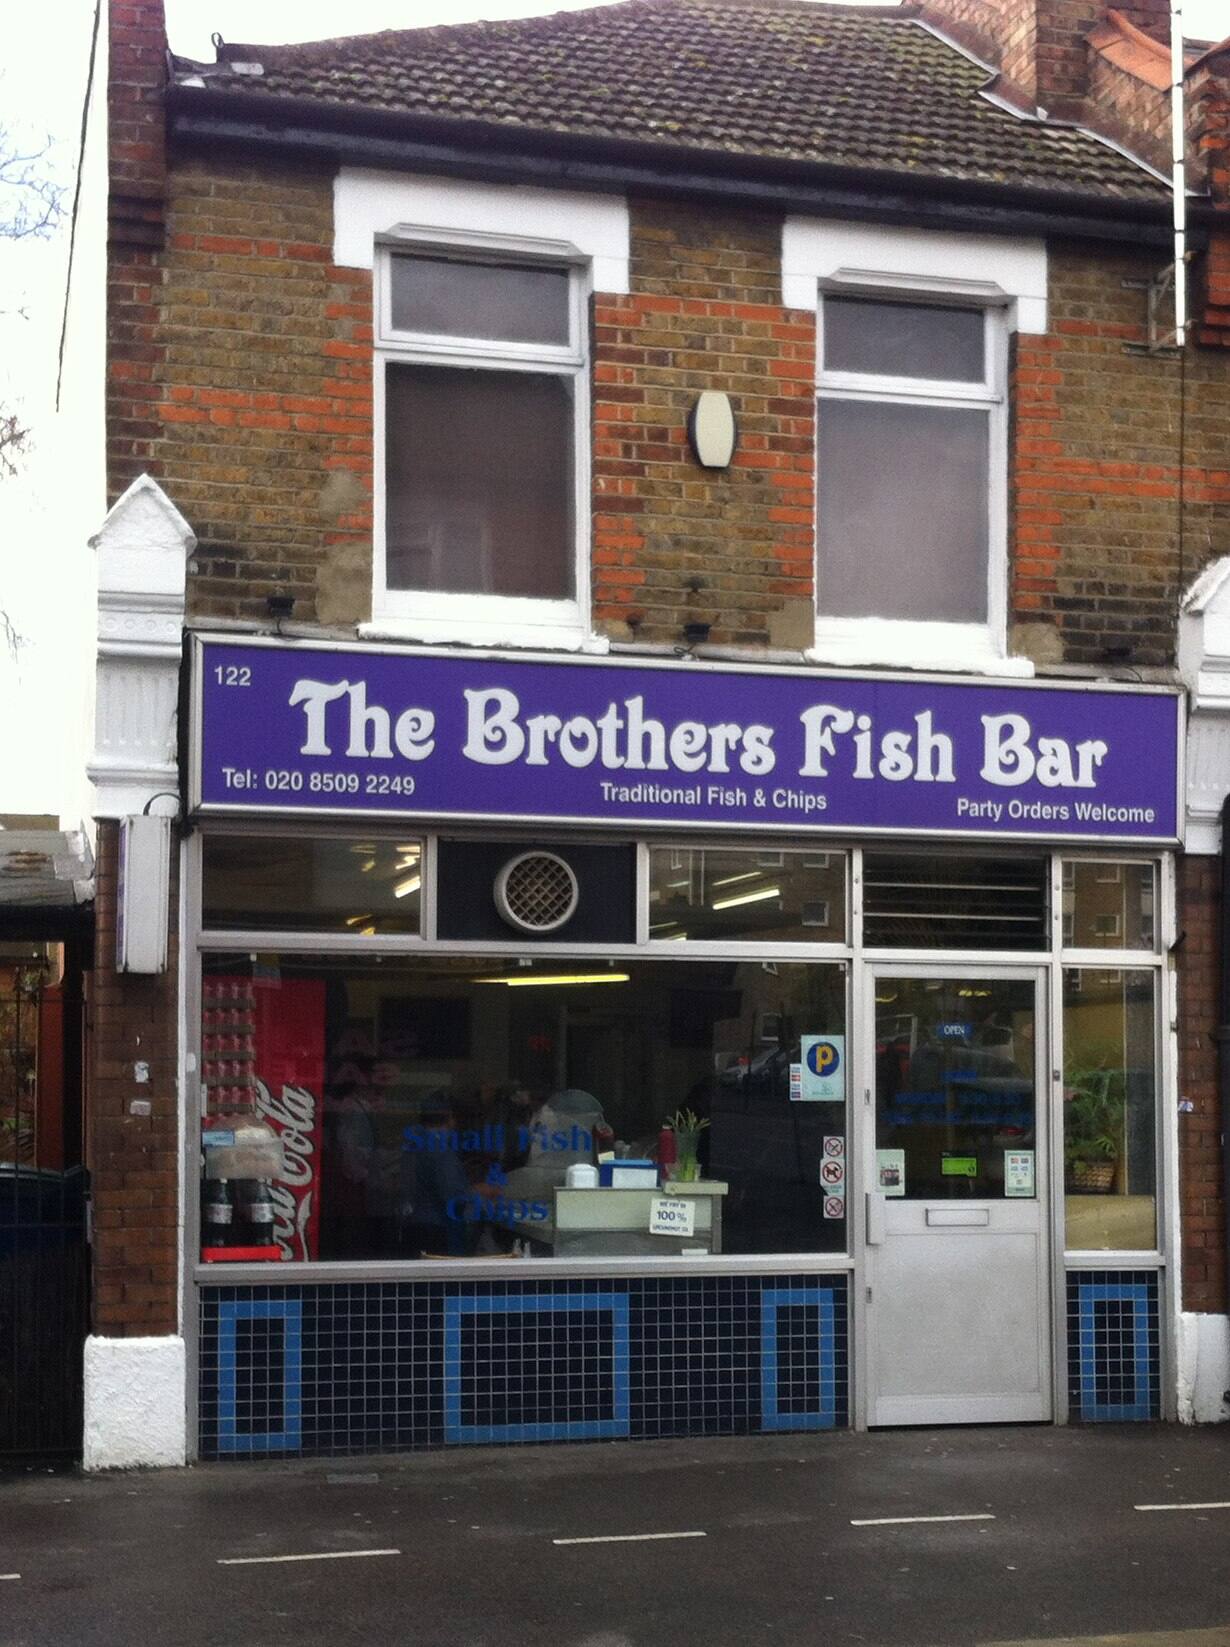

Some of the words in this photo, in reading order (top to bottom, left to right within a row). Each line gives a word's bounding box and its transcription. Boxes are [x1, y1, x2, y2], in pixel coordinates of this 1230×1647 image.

[214, 665, 251, 686] 122
[288, 679, 435, 761] The
[462, 687, 776, 776] Brothers
[798, 703, 957, 783] Fish
[979, 712, 1109, 788] Bar
[222, 767, 258, 788] Tel:
[265, 770, 303, 791] 020
[309, 772, 360, 793] 8509
[365, 774, 415, 795] 2249
[600, 782, 701, 805] Traditional
[707, 786, 747, 807] Fish
[753, 788, 766, 807] &
[772, 788, 827, 814] Chips
[957, 797, 1003, 822] Party
[1008, 799, 1070, 820] Orders
[1074, 802, 1155, 823] Welcome
[943, 1025, 965, 1035] OPEN
[401, 1123, 505, 1152] Small
[517, 1124, 592, 1153] Fish
[447, 1193, 549, 1228] Chips
